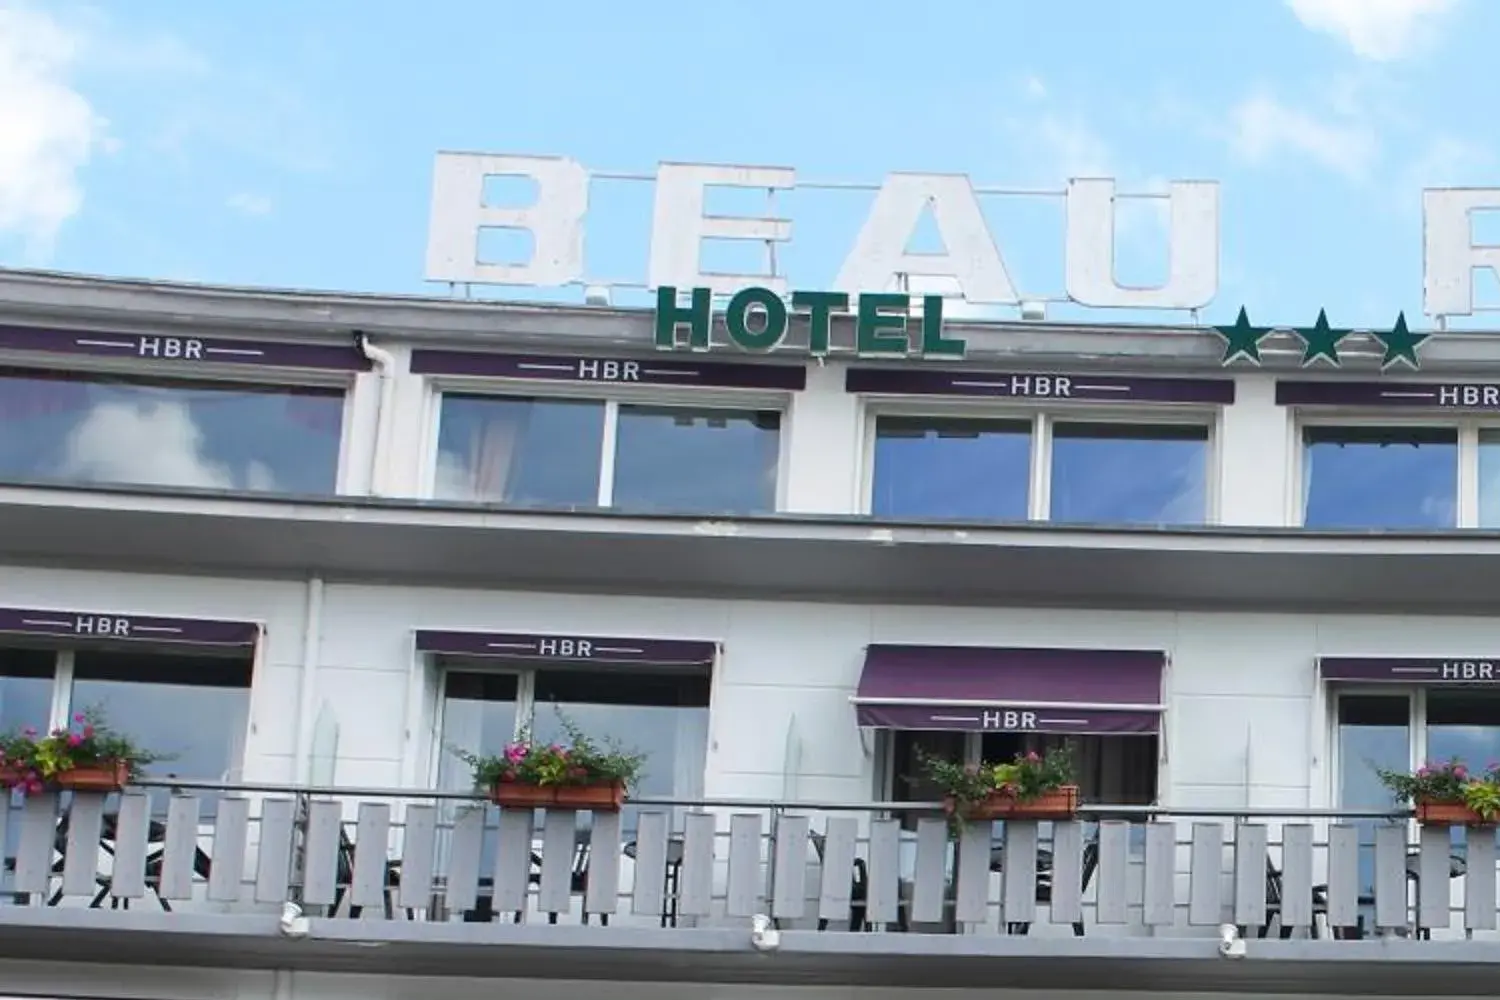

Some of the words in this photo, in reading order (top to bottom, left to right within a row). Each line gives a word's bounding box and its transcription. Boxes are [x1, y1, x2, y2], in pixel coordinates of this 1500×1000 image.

[424, 150, 1221, 310] BEAU
[655, 285, 967, 361] HOTEL
[139, 337, 203, 359] HBR
[578, 359, 640, 381] HBR
[1011, 375, 1071, 396] HBR
[1439, 386, 1499, 405] HBR
[76, 616, 129, 636] HBR
[539, 639, 592, 657] HBR
[1442, 661, 1493, 679] HBR
[983, 711, 1036, 729] HBR
